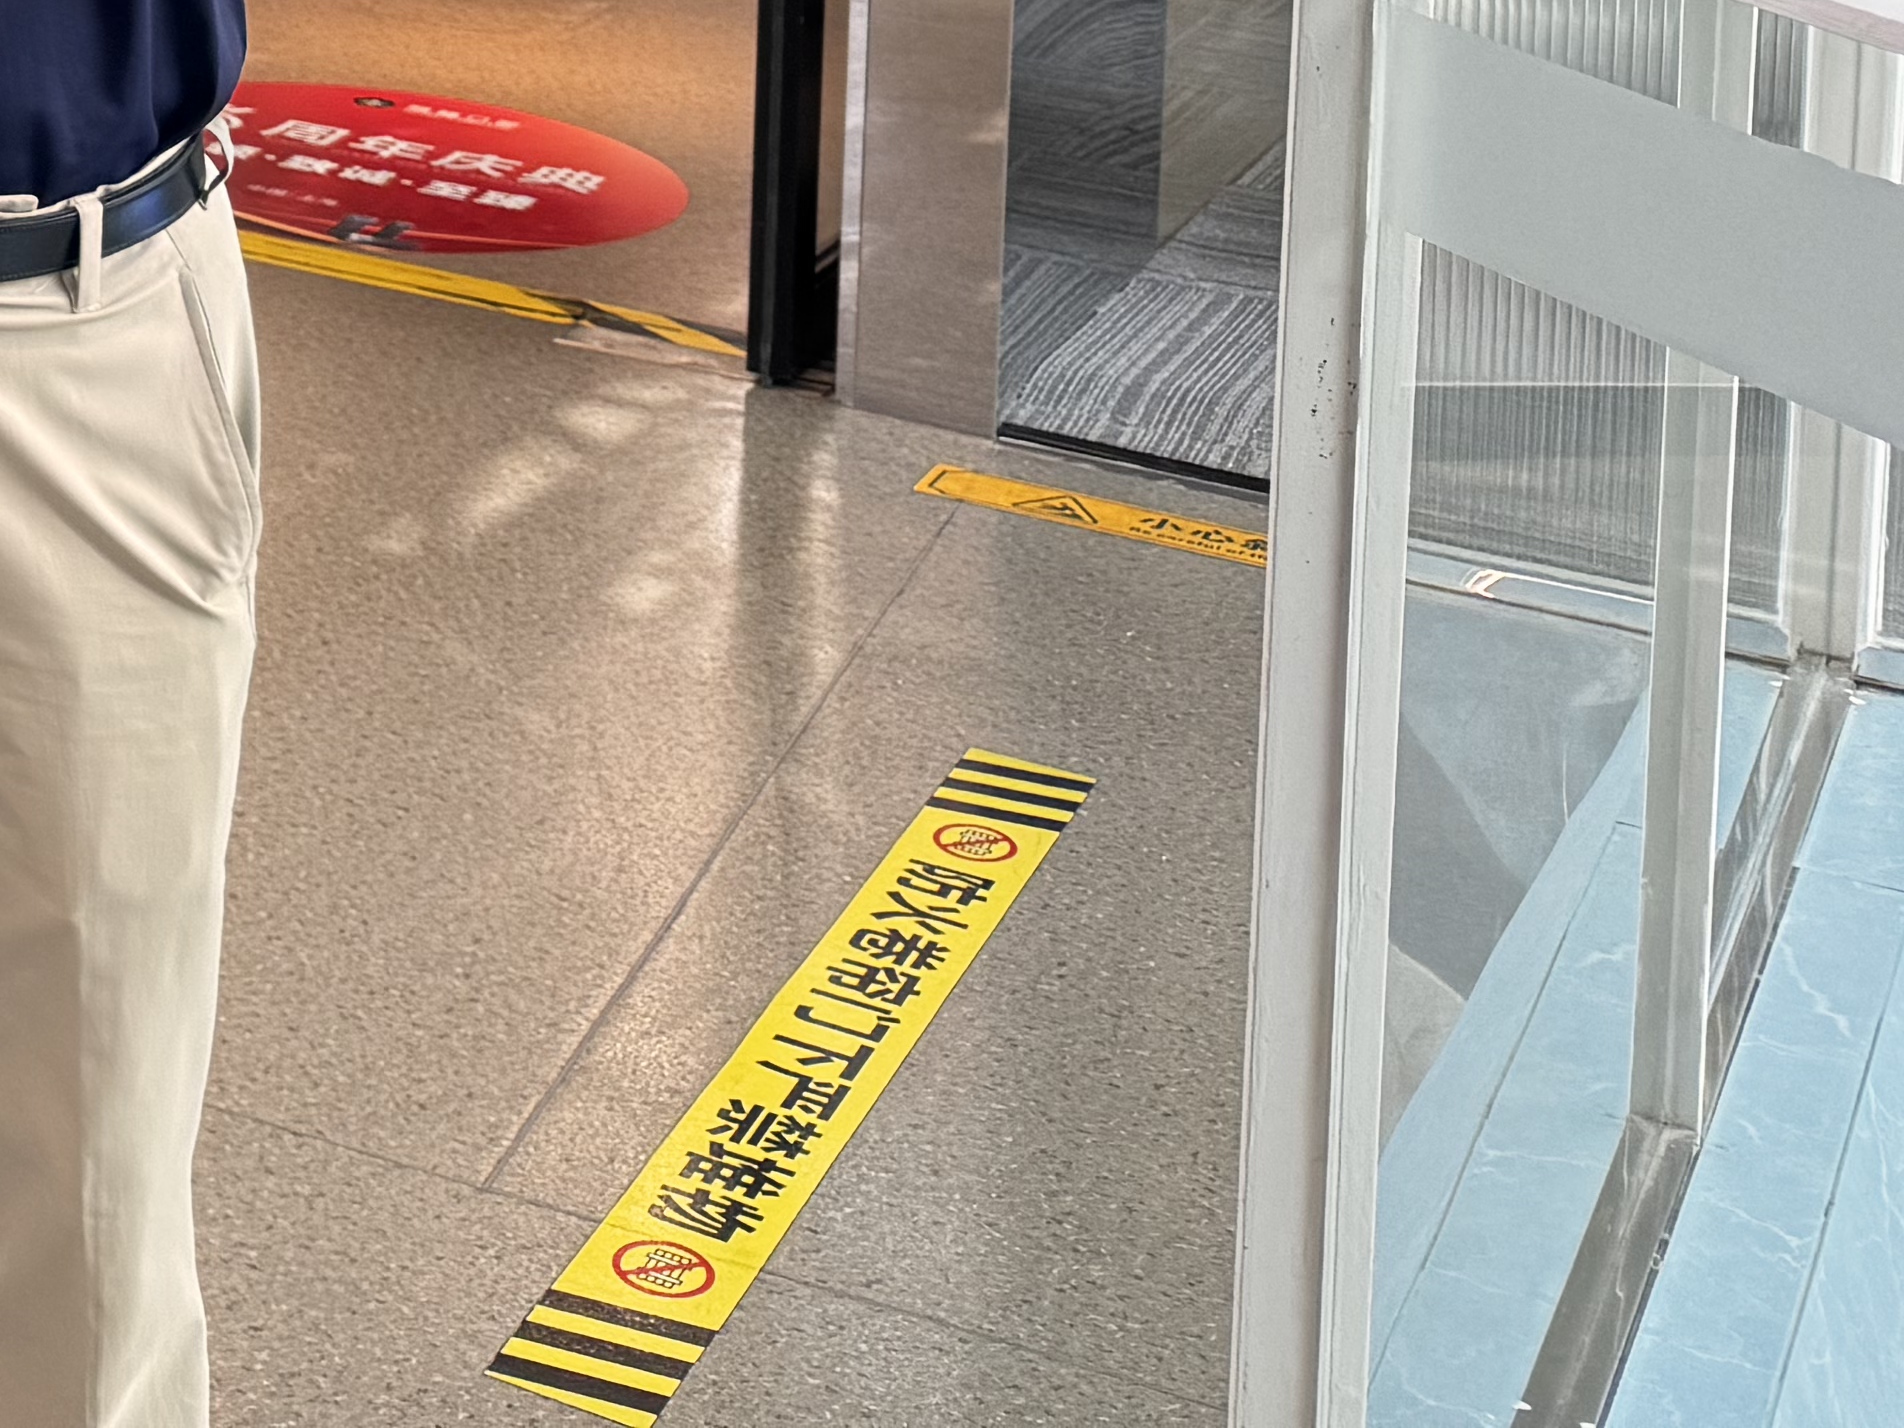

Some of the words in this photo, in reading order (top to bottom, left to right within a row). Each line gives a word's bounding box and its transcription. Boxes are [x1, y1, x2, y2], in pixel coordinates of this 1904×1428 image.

[648, 856, 998, 1245] 防火卷帘门下严禁堆物
